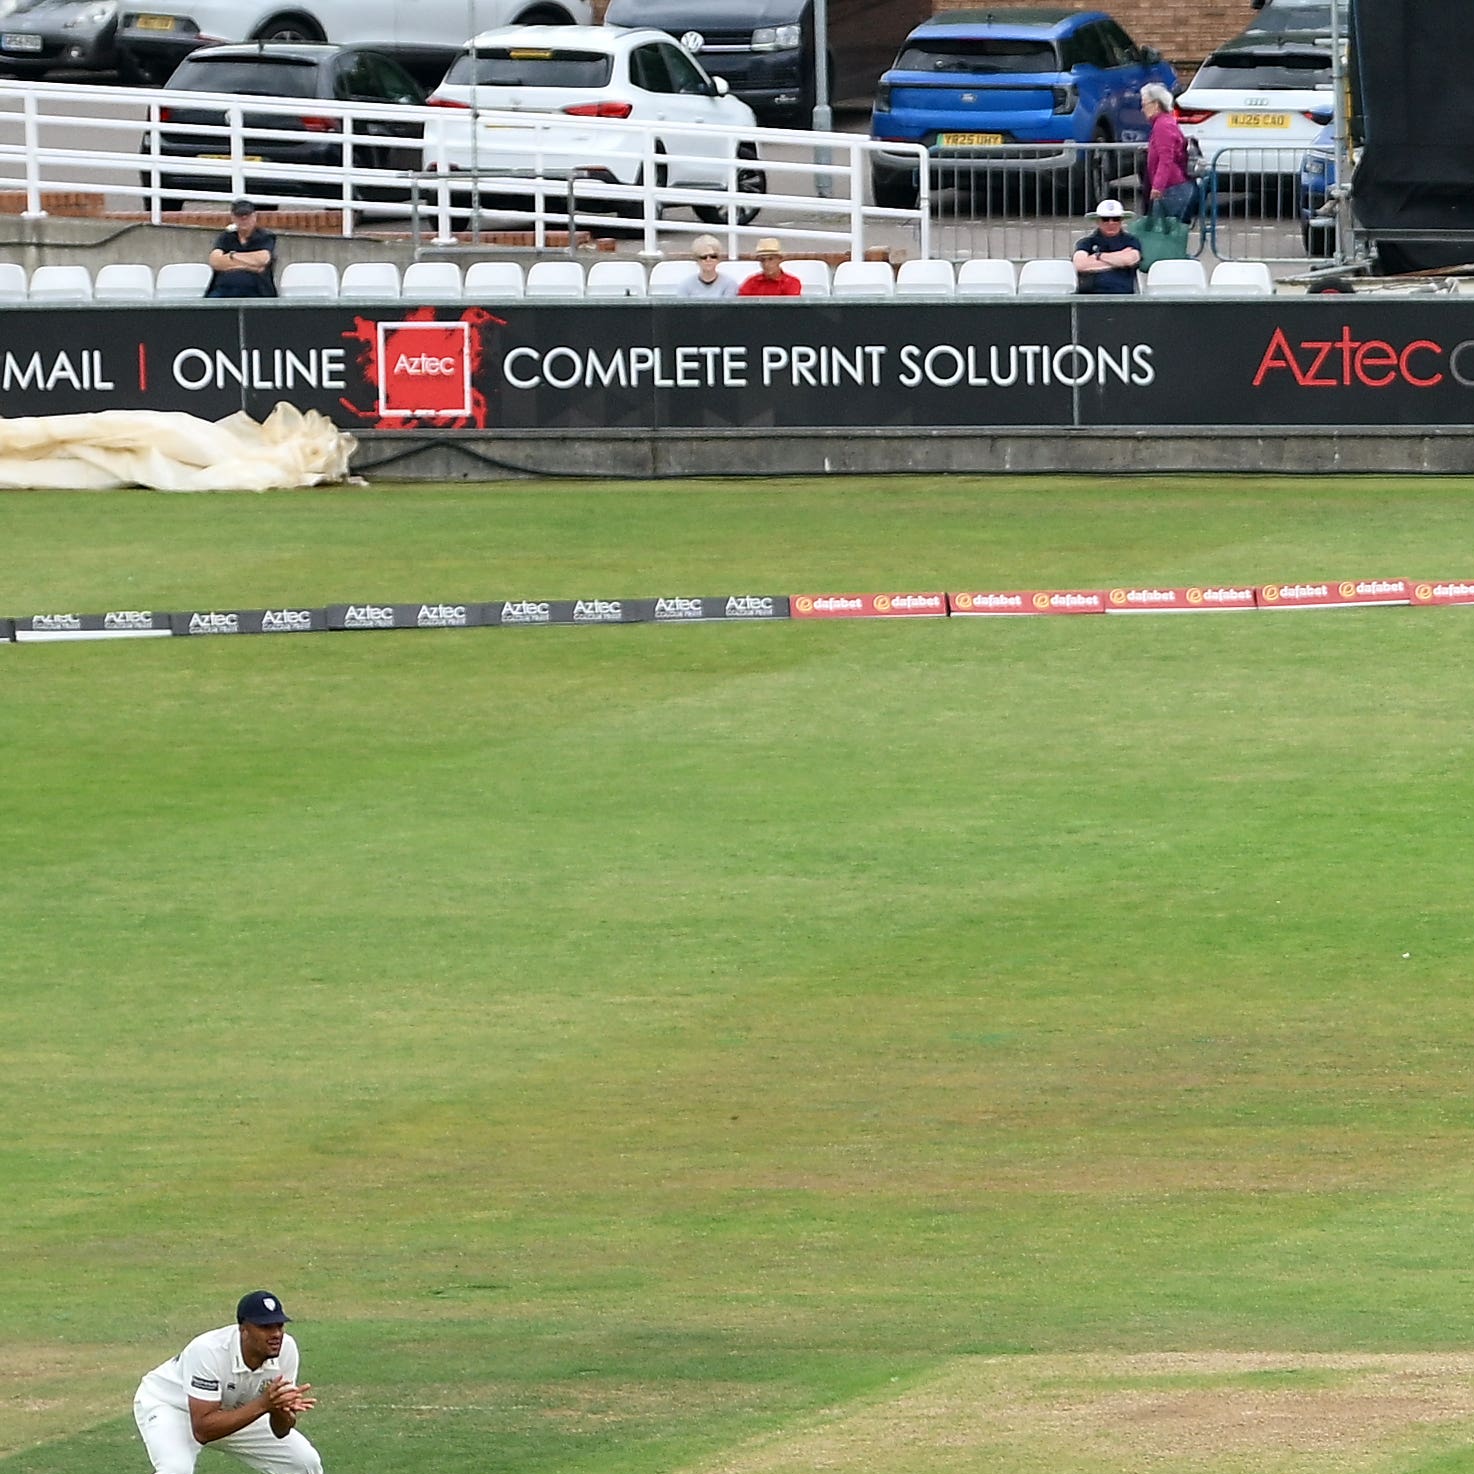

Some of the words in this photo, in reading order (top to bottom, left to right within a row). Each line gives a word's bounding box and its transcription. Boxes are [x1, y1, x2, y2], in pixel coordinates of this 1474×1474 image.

[3, 350, 114, 391] MAIL
[172, 348, 346, 390] ONLINE
[393, 352, 455, 376] Aztec
[503, 346, 747, 389] COMPLETE
[762, 345, 886, 386] PRINT
[899, 344, 1155, 387] SOLUTIONS
[1202, 588, 1251, 602] dafabet
[1278, 585, 1327, 599] dafabet
[1355, 581, 1404, 595] dafabet
[654, 596, 702, 610] Aztec
[724, 594, 772, 609] Aztec
[812, 597, 861, 611] dafabet
[890, 595, 939, 609] dafabet
[972, 594, 1021, 608] dafabet
[1049, 594, 1098, 608] dafabet
[1125, 590, 1174, 604] dafabet
[344, 604, 392, 619] Aztec
[418, 604, 466, 618] Aztec
[500, 600, 548, 614] Aztec
[572, 598, 620, 613] Aztec
[188, 612, 236, 626] Aztec
[262, 608, 310, 623] Aztec
